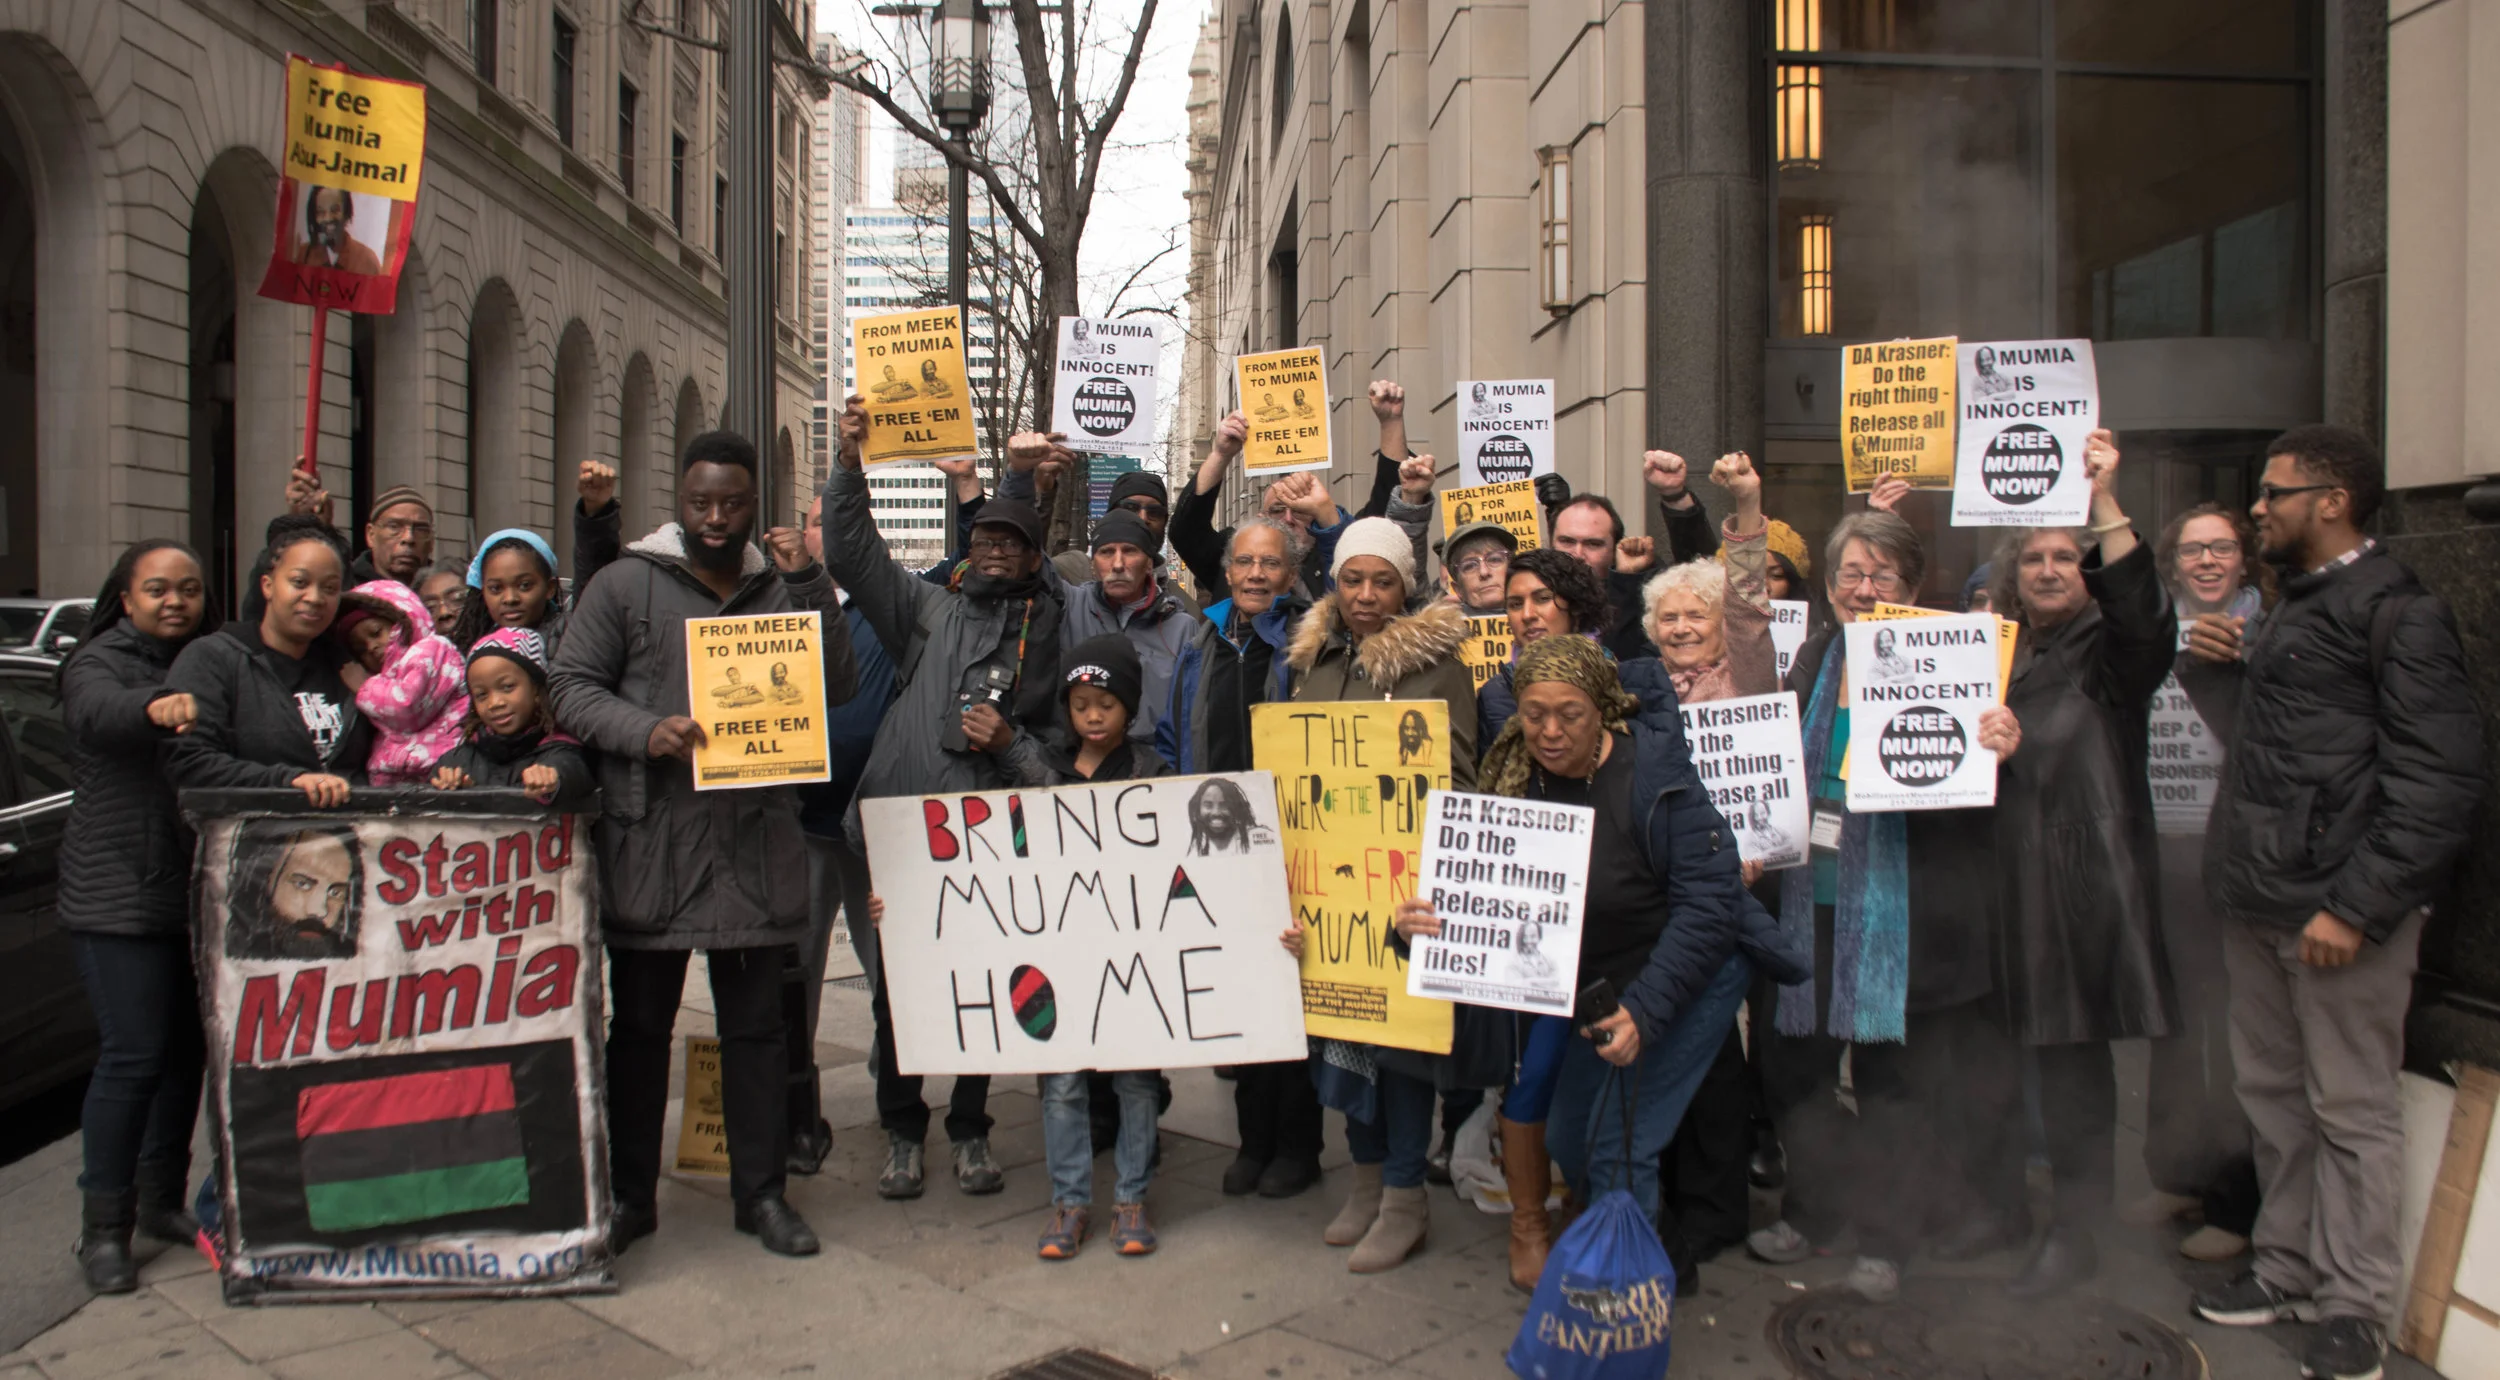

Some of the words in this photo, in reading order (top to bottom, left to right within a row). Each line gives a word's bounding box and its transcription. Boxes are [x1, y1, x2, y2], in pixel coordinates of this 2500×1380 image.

[307, 78, 371, 117] Free
[289, 141, 407, 184] Abu-Jamal
[862, 324, 901, 339] FROM
[906, 316, 957, 334] MEEK
[1096, 324, 1154, 338] MUMIA
[868, 345, 886, 358] TO
[892, 336, 954, 355] MUMIA
[1100, 343, 1116, 355] IS
[1852, 347, 1873, 365] DA
[1877, 344, 1951, 363] Krasner:
[2000, 347, 2076, 366] MUMIA
[1061, 360, 1154, 377] INNOCENT!
[1245, 362, 1277, 374] FROM
[1280, 355, 1320, 369] MEEK
[1873, 366, 1893, 384] Do
[1898, 364, 1926, 382] the
[1083, 381, 1127, 396] FREE
[1250, 378, 1266, 387] TO
[1270, 371, 1317, 385] MUMIA
[2014, 376, 2036, 391] IS
[1492, 384, 1546, 396] MUMIA
[1849, 388, 1890, 408] right
[1894, 385, 1938, 404] thing
[1074, 398, 1133, 413] MUMIA
[1498, 403, 1513, 413] IS
[1967, 400, 2087, 420] INNOCENT!
[874, 411, 922, 427] FREE
[1081, 415, 1126, 430] NOW!
[1464, 419, 1549, 432] INNOCENT!
[1850, 414, 1918, 434] Release
[1923, 410, 1945, 429] all
[903, 429, 938, 443] ALL
[1256, 429, 1291, 442] FREE
[1867, 434, 1925, 453] Mumia
[1995, 431, 2053, 450] FREE
[1275, 444, 1301, 455] ALL
[1485, 440, 1525, 452] FREE
[1479, 456, 1533, 468] MUMIA
[1873, 455, 1917, 474] files!
[1984, 454, 2060, 473] MUMIA
[1486, 471, 1526, 483] NOW!
[1990, 477, 2050, 496] NOW!
[1447, 481, 1530, 501] HEALTHCARE
[1481, 499, 1505, 510] FOR
[1481, 510, 1533, 525] MUMIA
[1511, 526, 1535, 537] ALL
[699, 623, 748, 638] FROM
[754, 617, 813, 635] MEEK
[706, 645, 729, 658] TO
[737, 638, 808, 656] MUMIA
[1905, 629, 1987, 648] MUMIA
[1484, 640, 1506, 657] Do
[1914, 658, 1936, 673] IS
[1862, 683, 1993, 701] INNOCENT!
[1698, 702, 1789, 730] Krasner:
[1892, 713, 1954, 732] FREE
[714, 720, 767, 736] FREE
[2188, 721, 2201, 737] C
[744, 740, 783, 756] ALL
[1289, 713, 1369, 767] THE
[1699, 733, 1734, 753] the
[1881, 736, 1965, 756] MUMIA
[1725, 753, 1782, 774] thing
[1890, 760, 1954, 779] NOW!
[2150, 764, 2221, 780] ISONERS
[1708, 784, 1756, 806] ease
[1762, 778, 1790, 801] all
[2153, 784, 2197, 801] TOO!
[1274, 774, 1328, 832] WER
[1344, 786, 1372, 815] THE
[1376, 774, 1449, 834] PEOP
[923, 784, 1159, 863] BRING
[1441, 796, 1472, 822] DA
[1479, 799, 1586, 835] Krasner:
[1438, 825, 1470, 851] Do
[1477, 830, 1516, 857] the
[376, 813, 574, 905] Stand
[1365, 847, 1418, 901] FRE
[1435, 856, 1496, 884] right
[1501, 862, 1567, 895] thing
[936, 865, 1217, 940] MUMIA
[1431, 887, 1531, 922] Release
[1537, 900, 1570, 926] all
[396, 884, 556, 952] with
[1424, 946, 1487, 976] files!
[232, 935, 580, 1065] Mumia
[951, 945, 1243, 1054] HOME
[693, 1044, 720, 1053] FRO
[698, 1061, 715, 1072] TO
[696, 1123, 726, 1136] FRE
[250, 1244, 584, 1279] www.Mumia.org
